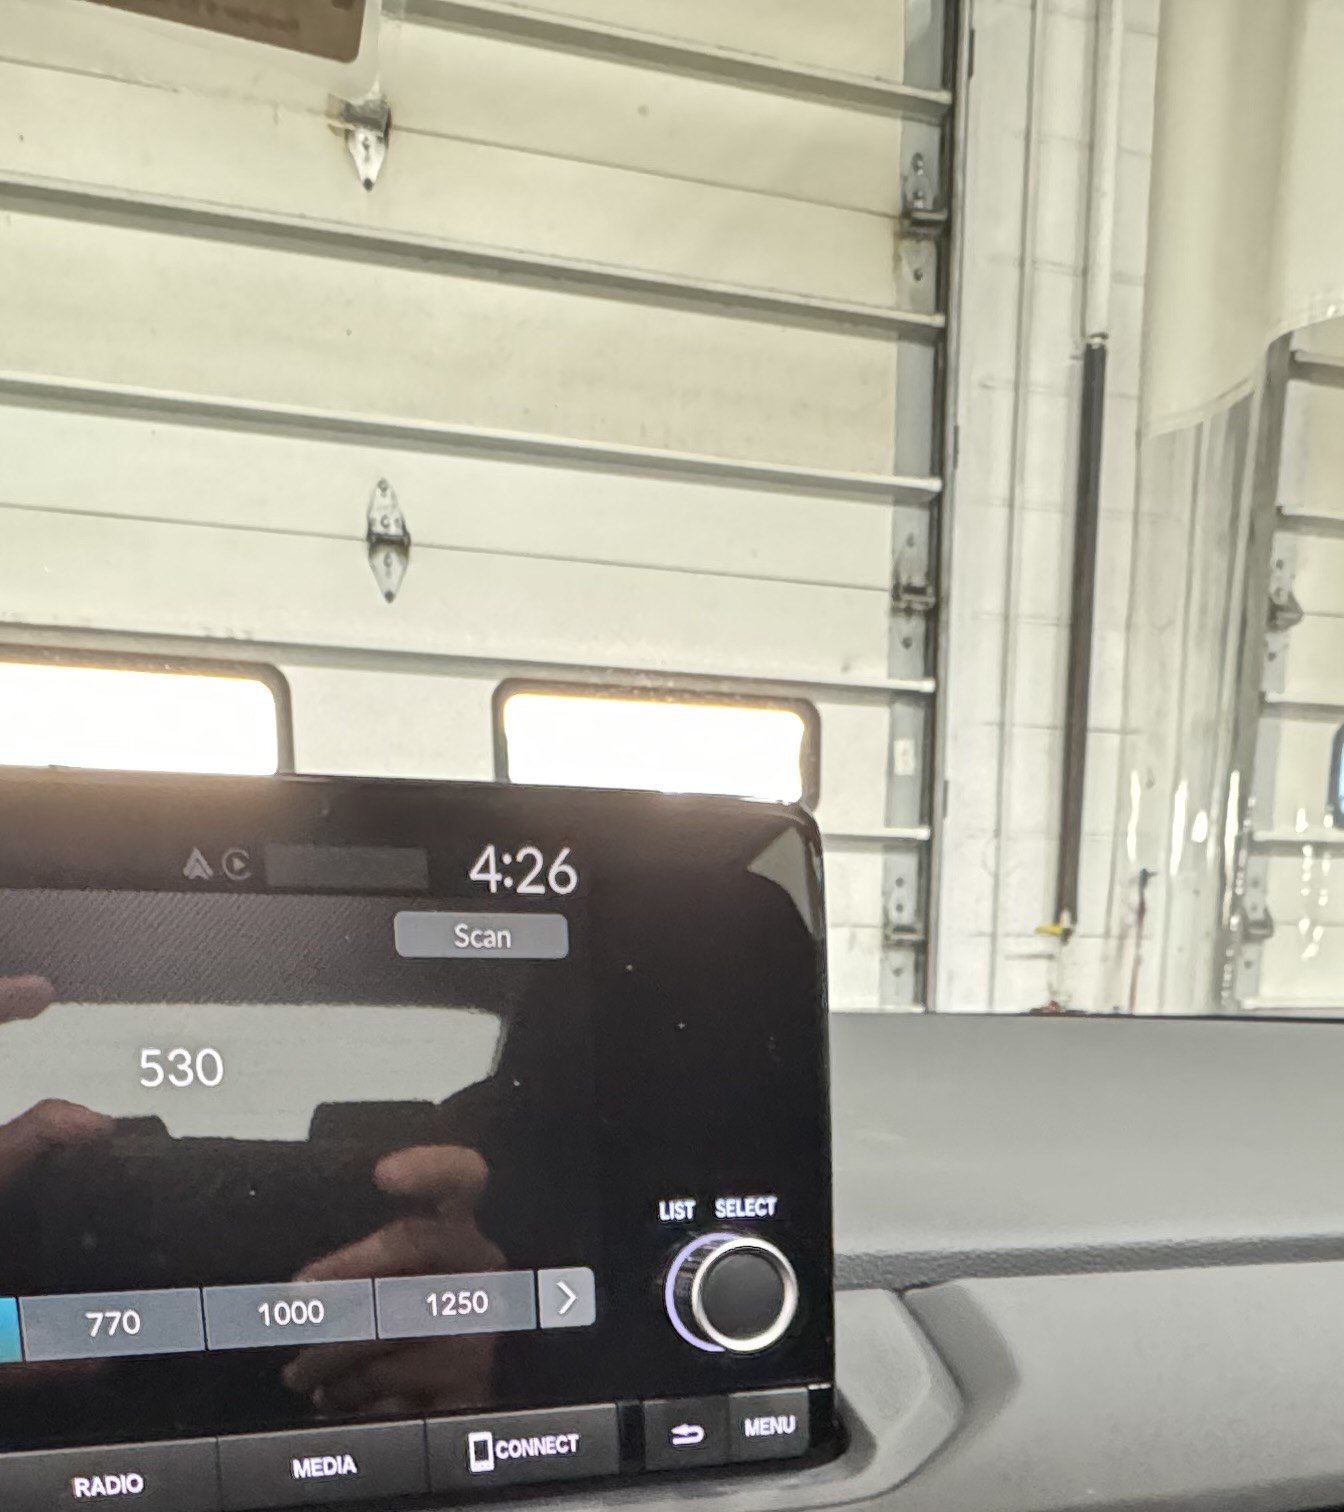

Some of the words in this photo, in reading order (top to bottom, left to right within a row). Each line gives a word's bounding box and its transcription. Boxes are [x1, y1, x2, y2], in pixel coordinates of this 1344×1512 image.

[469, 845, 578, 895] 4:26
[454, 923, 512, 949] Scan
[140, 1046, 224, 1087] 530
[658, 1199, 697, 1221] LIST
[714, 1195, 778, 1219] SELECT
[258, 1299, 325, 1327] 1000
[426, 1290, 489, 1317] 1250
[85, 1309, 141, 1337] 770
[744, 1414, 796, 1437] MENU
[495, 1433, 580, 1460] CONNECT
[292, 1454, 358, 1479] MEDIA
[73, 1472, 144, 1498] RADIO
